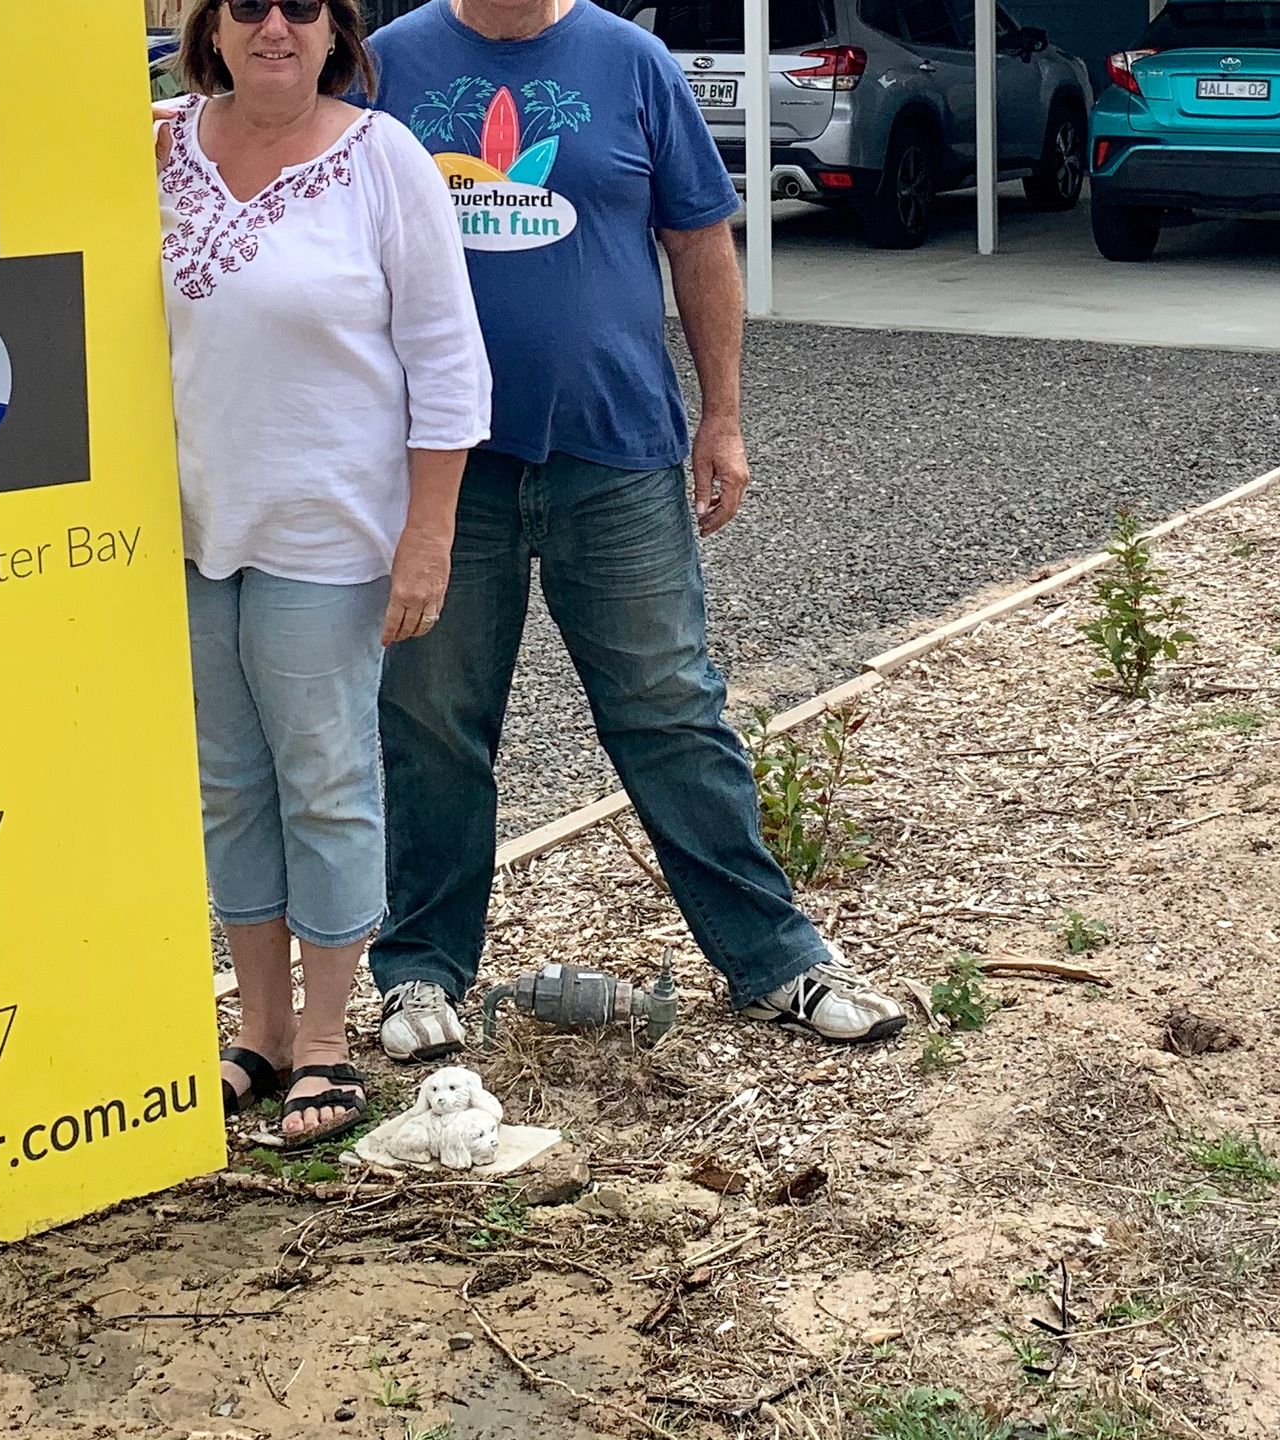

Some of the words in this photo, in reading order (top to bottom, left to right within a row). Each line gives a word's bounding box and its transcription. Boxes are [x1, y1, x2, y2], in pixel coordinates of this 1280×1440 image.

[690, 84, 705, 97] 90
[710, 84, 732, 98] BWR
[1199, 82, 1234, 96] HALL
[448, 174, 474, 190] Go
[458, 210, 501, 235] ith
[509, 211, 560, 236] fun
[67, 525, 142, 569] Bay
